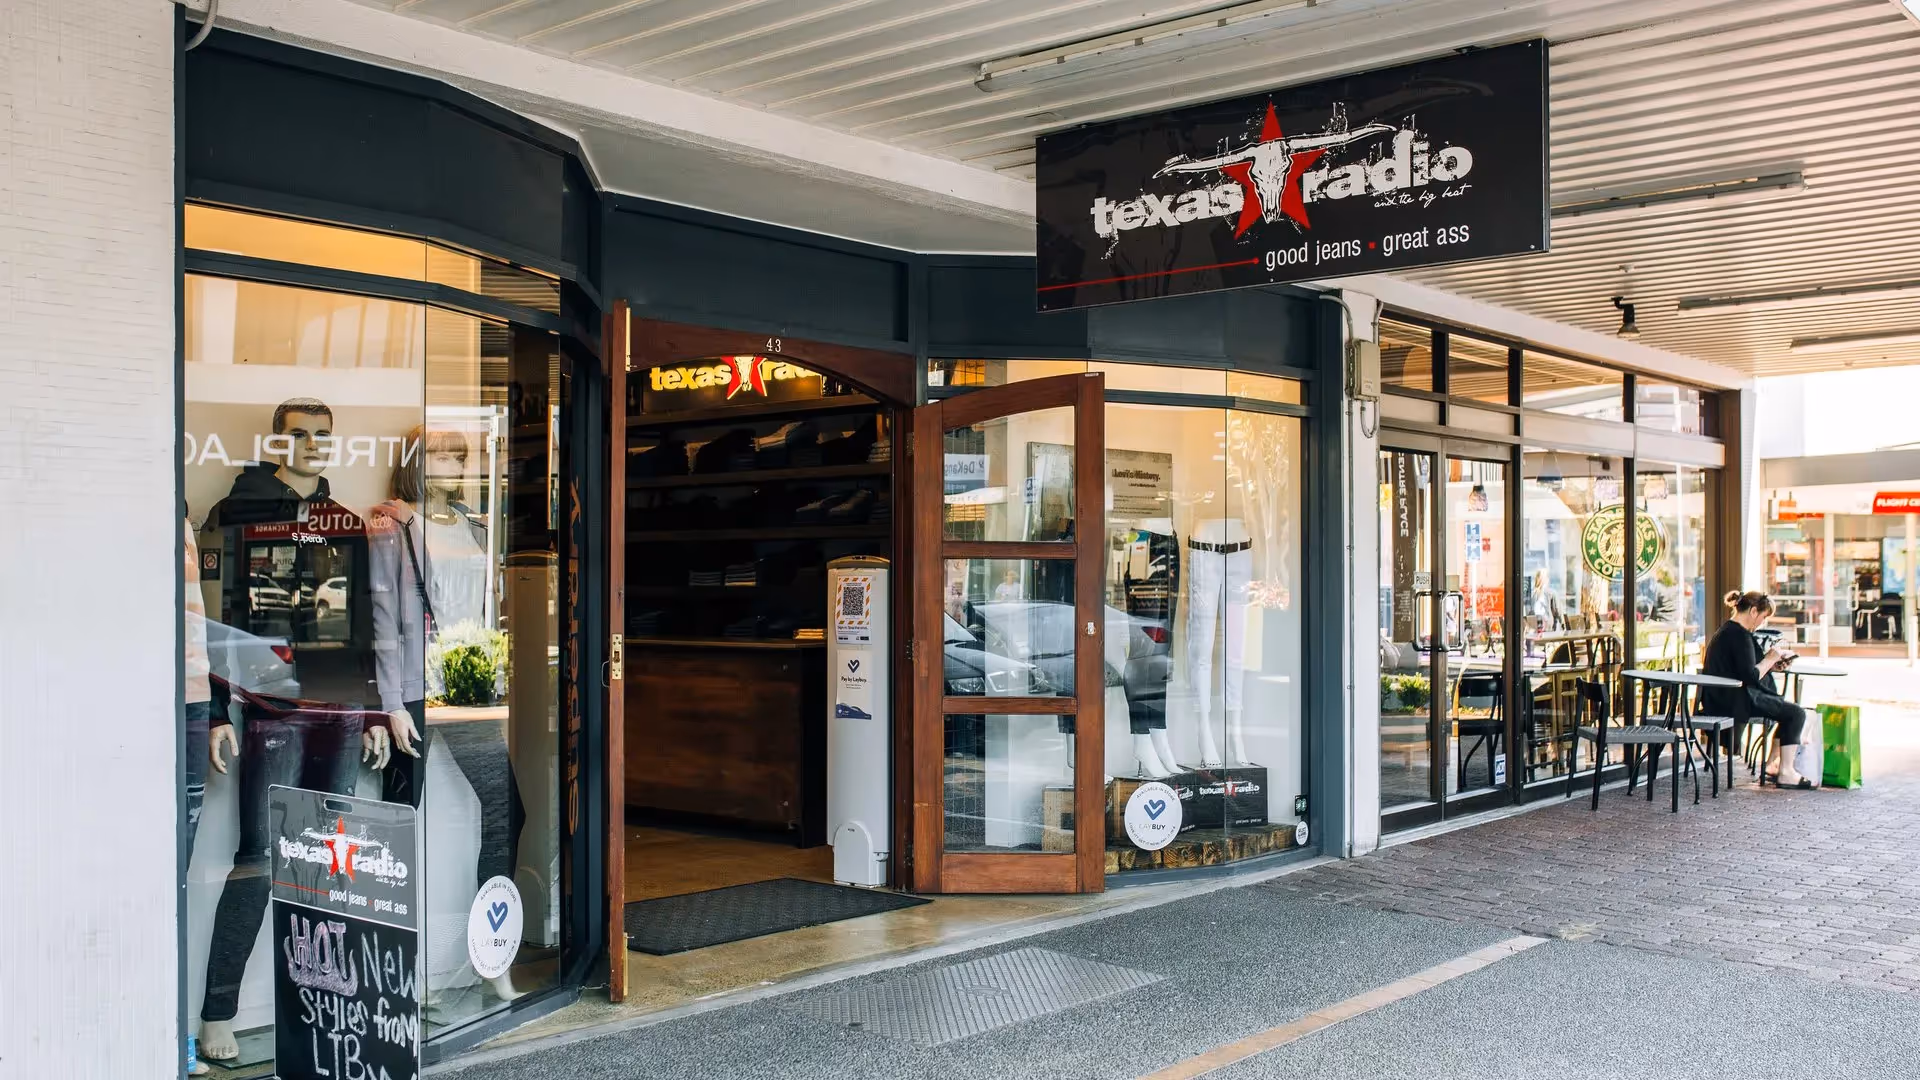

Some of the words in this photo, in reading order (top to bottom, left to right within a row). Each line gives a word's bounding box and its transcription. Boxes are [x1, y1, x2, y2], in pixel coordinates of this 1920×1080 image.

[1091, 183, 1243, 234] texas
[1303, 129, 1473, 202] radio
[1374, 195, 1397, 207] and
[1398, 193, 1414, 204] the
[1419, 190, 1436, 208] big
[1442, 183, 1472, 198] beat
[1265, 241, 1309, 271] good
[1315, 239, 1362, 266] jeans
[1383, 226, 1429, 257] great
[1437, 224, 1470, 245] ass
[766, 338, 782, 353] 43
[649, 364, 732, 391] texas
[1587, 507, 1655, 543] STARBKS
[1416, 575, 1431, 586] PUSH
[1594, 557, 1648, 578] COFE
[279, 836, 333, 866] texas
[352, 847, 408, 879] radio
[329, 889, 347, 903] good
[348, 890, 368, 907] jeans
[374, 897, 393, 913] great
[394, 903, 408, 915] ass
[290, 913, 348, 982] HOT
[299, 986, 369, 1037] Styles
